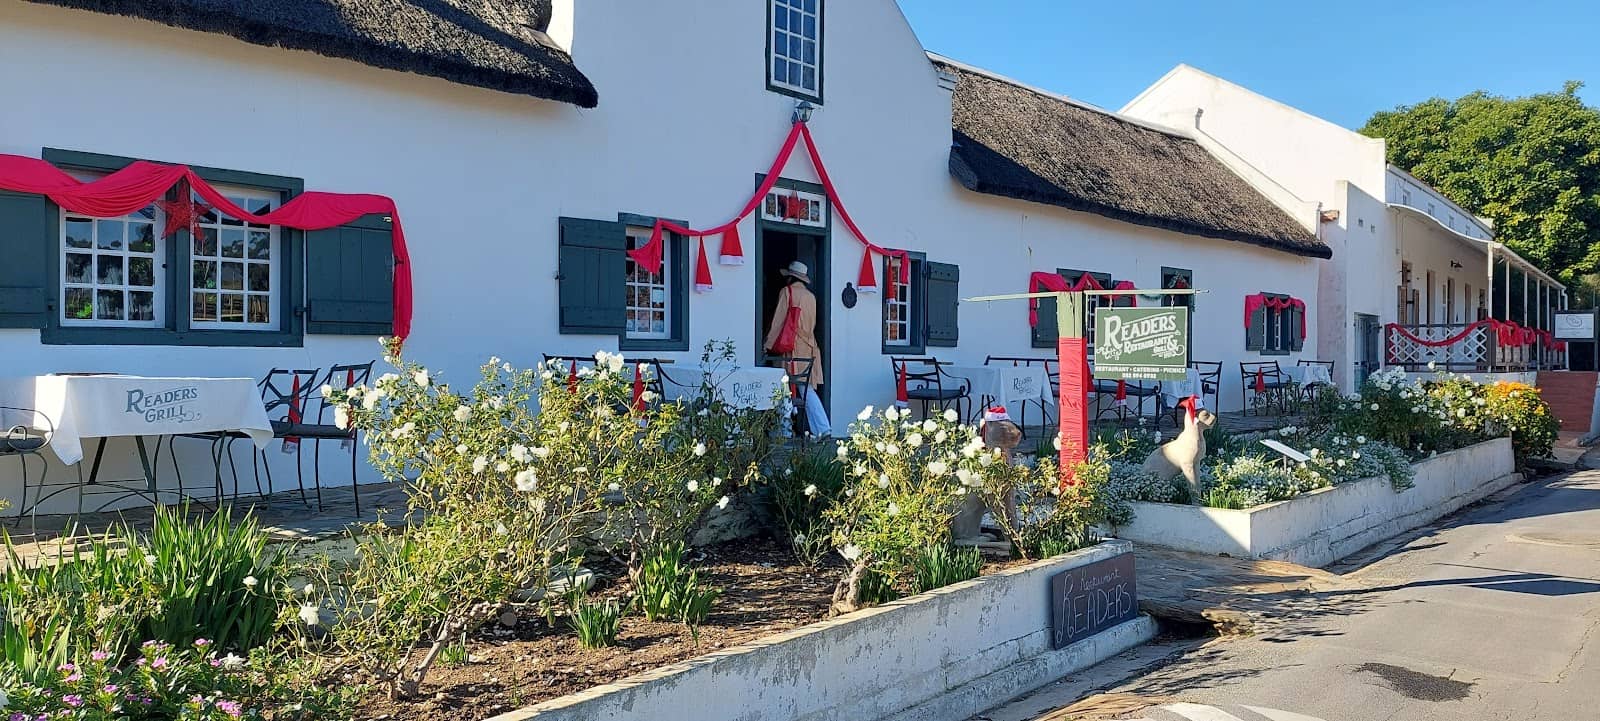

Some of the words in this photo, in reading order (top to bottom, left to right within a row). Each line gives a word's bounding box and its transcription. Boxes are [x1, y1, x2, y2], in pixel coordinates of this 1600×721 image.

[1103, 315, 1177, 351] READERS
[125, 387, 198, 414] READERS
[144, 404, 187, 423] GRILL
[1055, 573, 1132, 644] READERS
